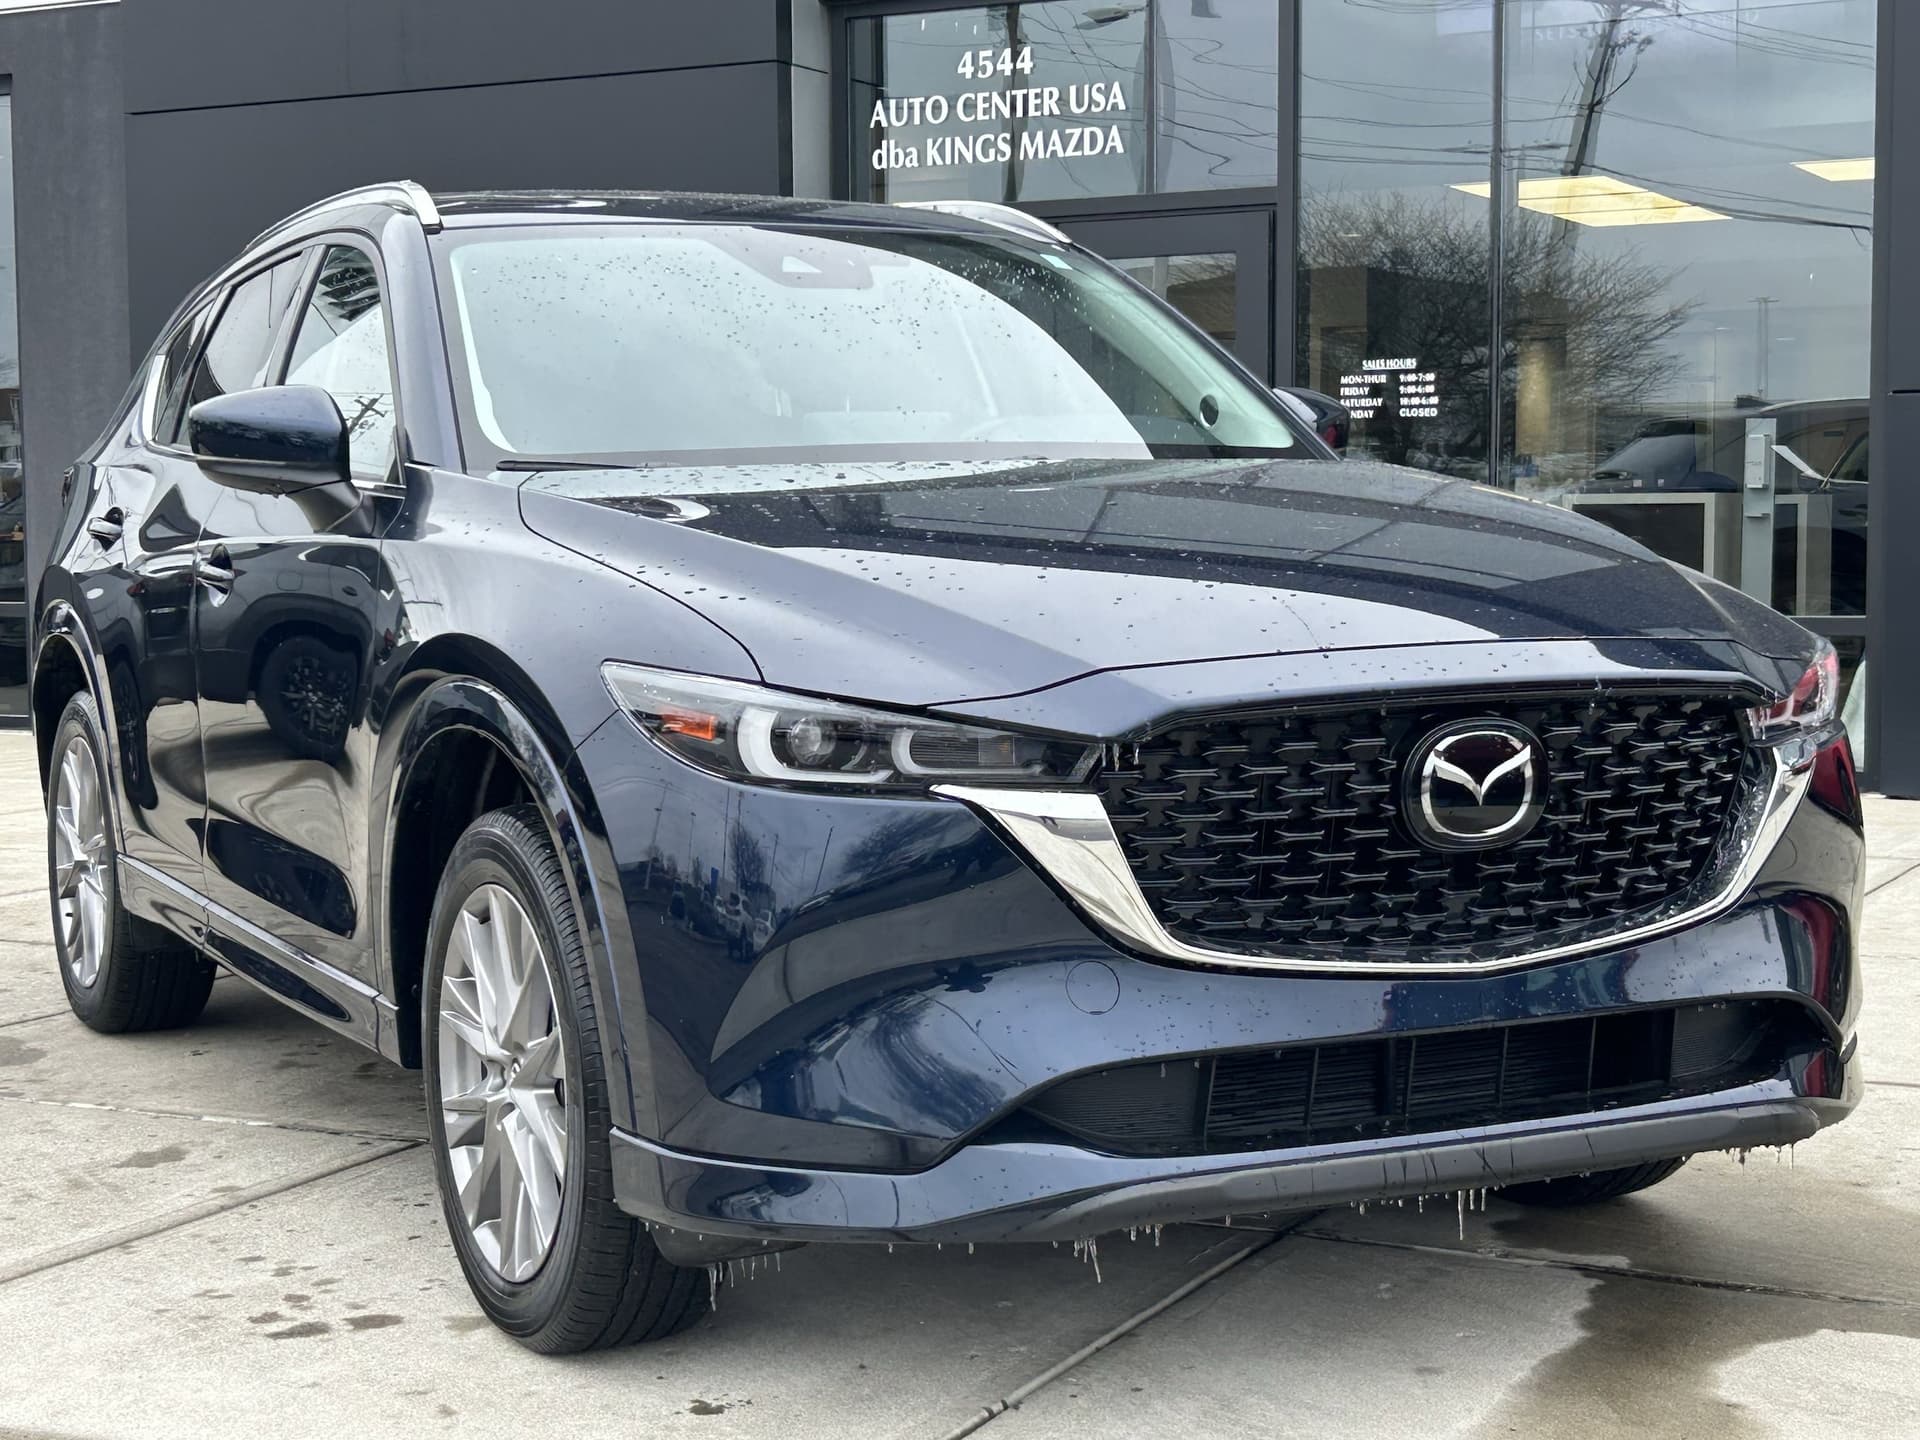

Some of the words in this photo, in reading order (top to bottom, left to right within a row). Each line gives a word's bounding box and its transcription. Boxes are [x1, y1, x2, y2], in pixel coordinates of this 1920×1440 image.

[957, 46, 1034, 79] 4544
[870, 95, 949, 128] AUTO
[956, 86, 1061, 122] CENTER
[1068, 81, 1126, 114] USA
[872, 139, 918, 170] dba
[926, 133, 1012, 167] KINGS
[1019, 124, 1125, 160] MAZDA
[1362, 359, 1385, 370] SALES
[1386, 358, 1417, 369] HOURS
[1340, 374, 1387, 384] MON-THUR
[1340, 387, 1370, 396] FRIDAY
[1340, 398, 1383, 407] SATURDAY
[1350, 410, 1374, 419] NDAY
[1399, 408, 1438, 417] CLOSED
